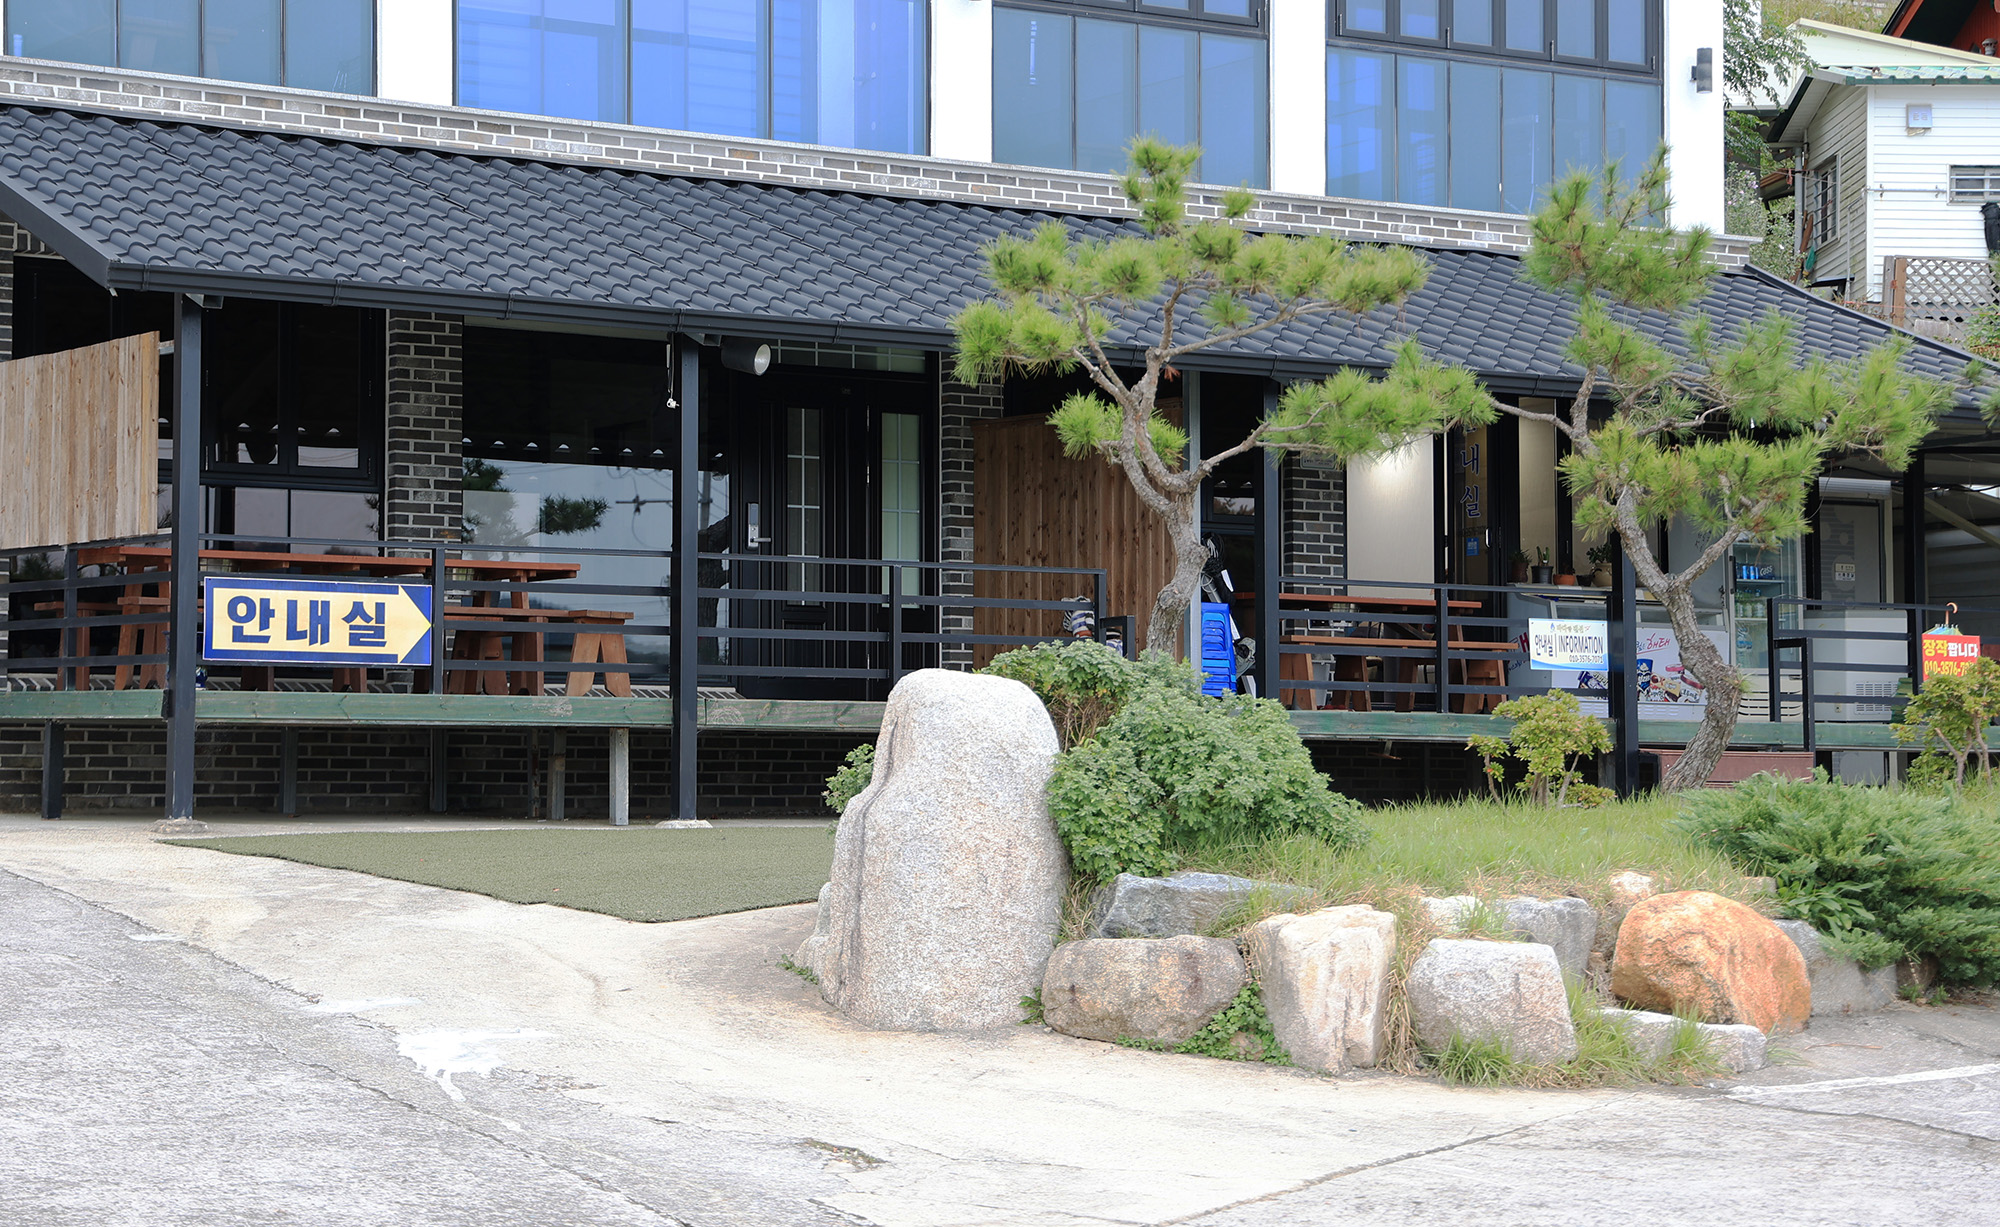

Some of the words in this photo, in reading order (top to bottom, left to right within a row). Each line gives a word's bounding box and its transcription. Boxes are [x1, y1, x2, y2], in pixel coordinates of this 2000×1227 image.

[1460, 426, 1481, 518] 내실
[227, 595, 388, 648] 안내실
[1534, 634, 1554, 657] 안내실
[1558, 635, 1604, 654] INFORMATION
